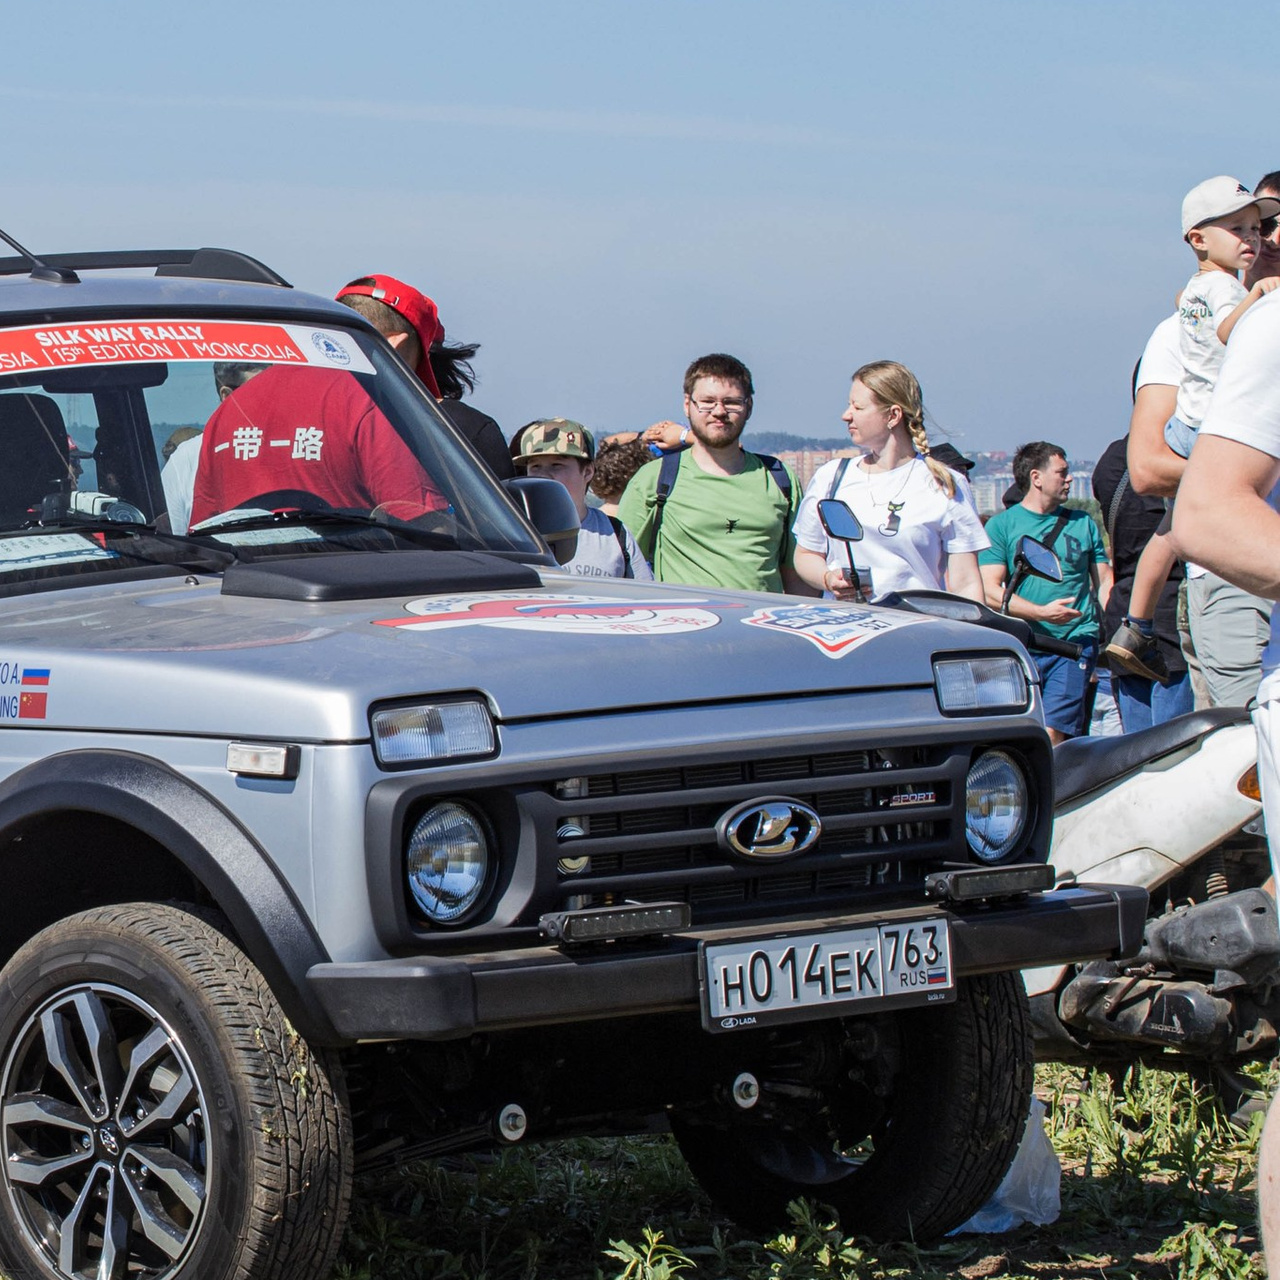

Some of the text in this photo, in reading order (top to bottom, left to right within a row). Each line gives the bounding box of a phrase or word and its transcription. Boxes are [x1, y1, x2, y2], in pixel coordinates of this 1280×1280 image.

[35, 326, 205, 347] SILK WAY RALLY
[52, 346, 85, 363] 15th
[87, 342, 173, 360] EDITION
[192, 341, 301, 361] MONGOLIA
[214, 426, 324, 461] 一带一路
[10, 662, 20, 684] A.
[893, 792, 934, 804] SPORT
[883, 926, 939, 973] 763
[900, 970, 927, 987] RUS
[738, 1016, 757, 1025] LADA
